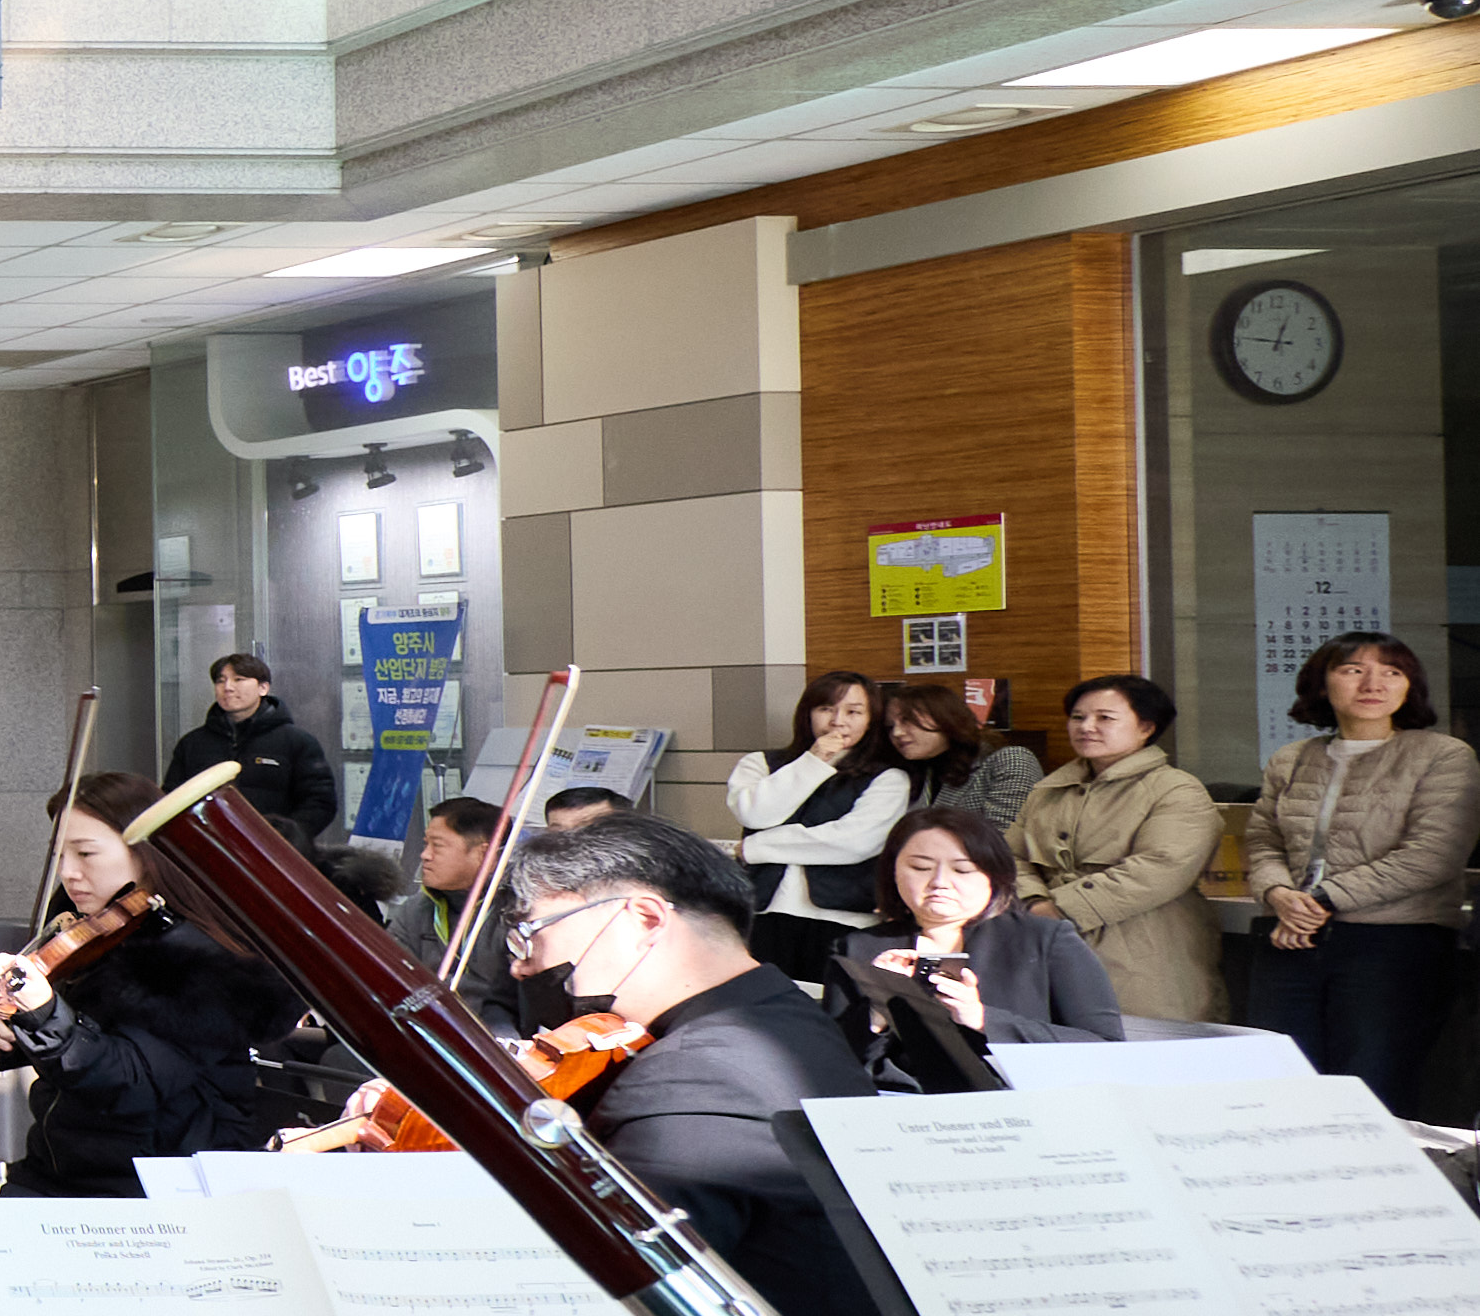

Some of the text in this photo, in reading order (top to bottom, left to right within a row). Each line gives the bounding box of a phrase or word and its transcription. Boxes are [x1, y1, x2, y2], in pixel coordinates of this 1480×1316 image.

[288, 343, 426, 403] Best 양주
[1315, 581, 1332, 594] 12
[392, 631, 435, 655] 양주시
[374, 657, 427, 681] 산업단지
[40, 1223, 188, 1235] Unter Donner und Blitz
[65, 1238, 171, 1250] (Thunder and Lightning)
[93, 1250, 151, 1260] Polka Schnell
